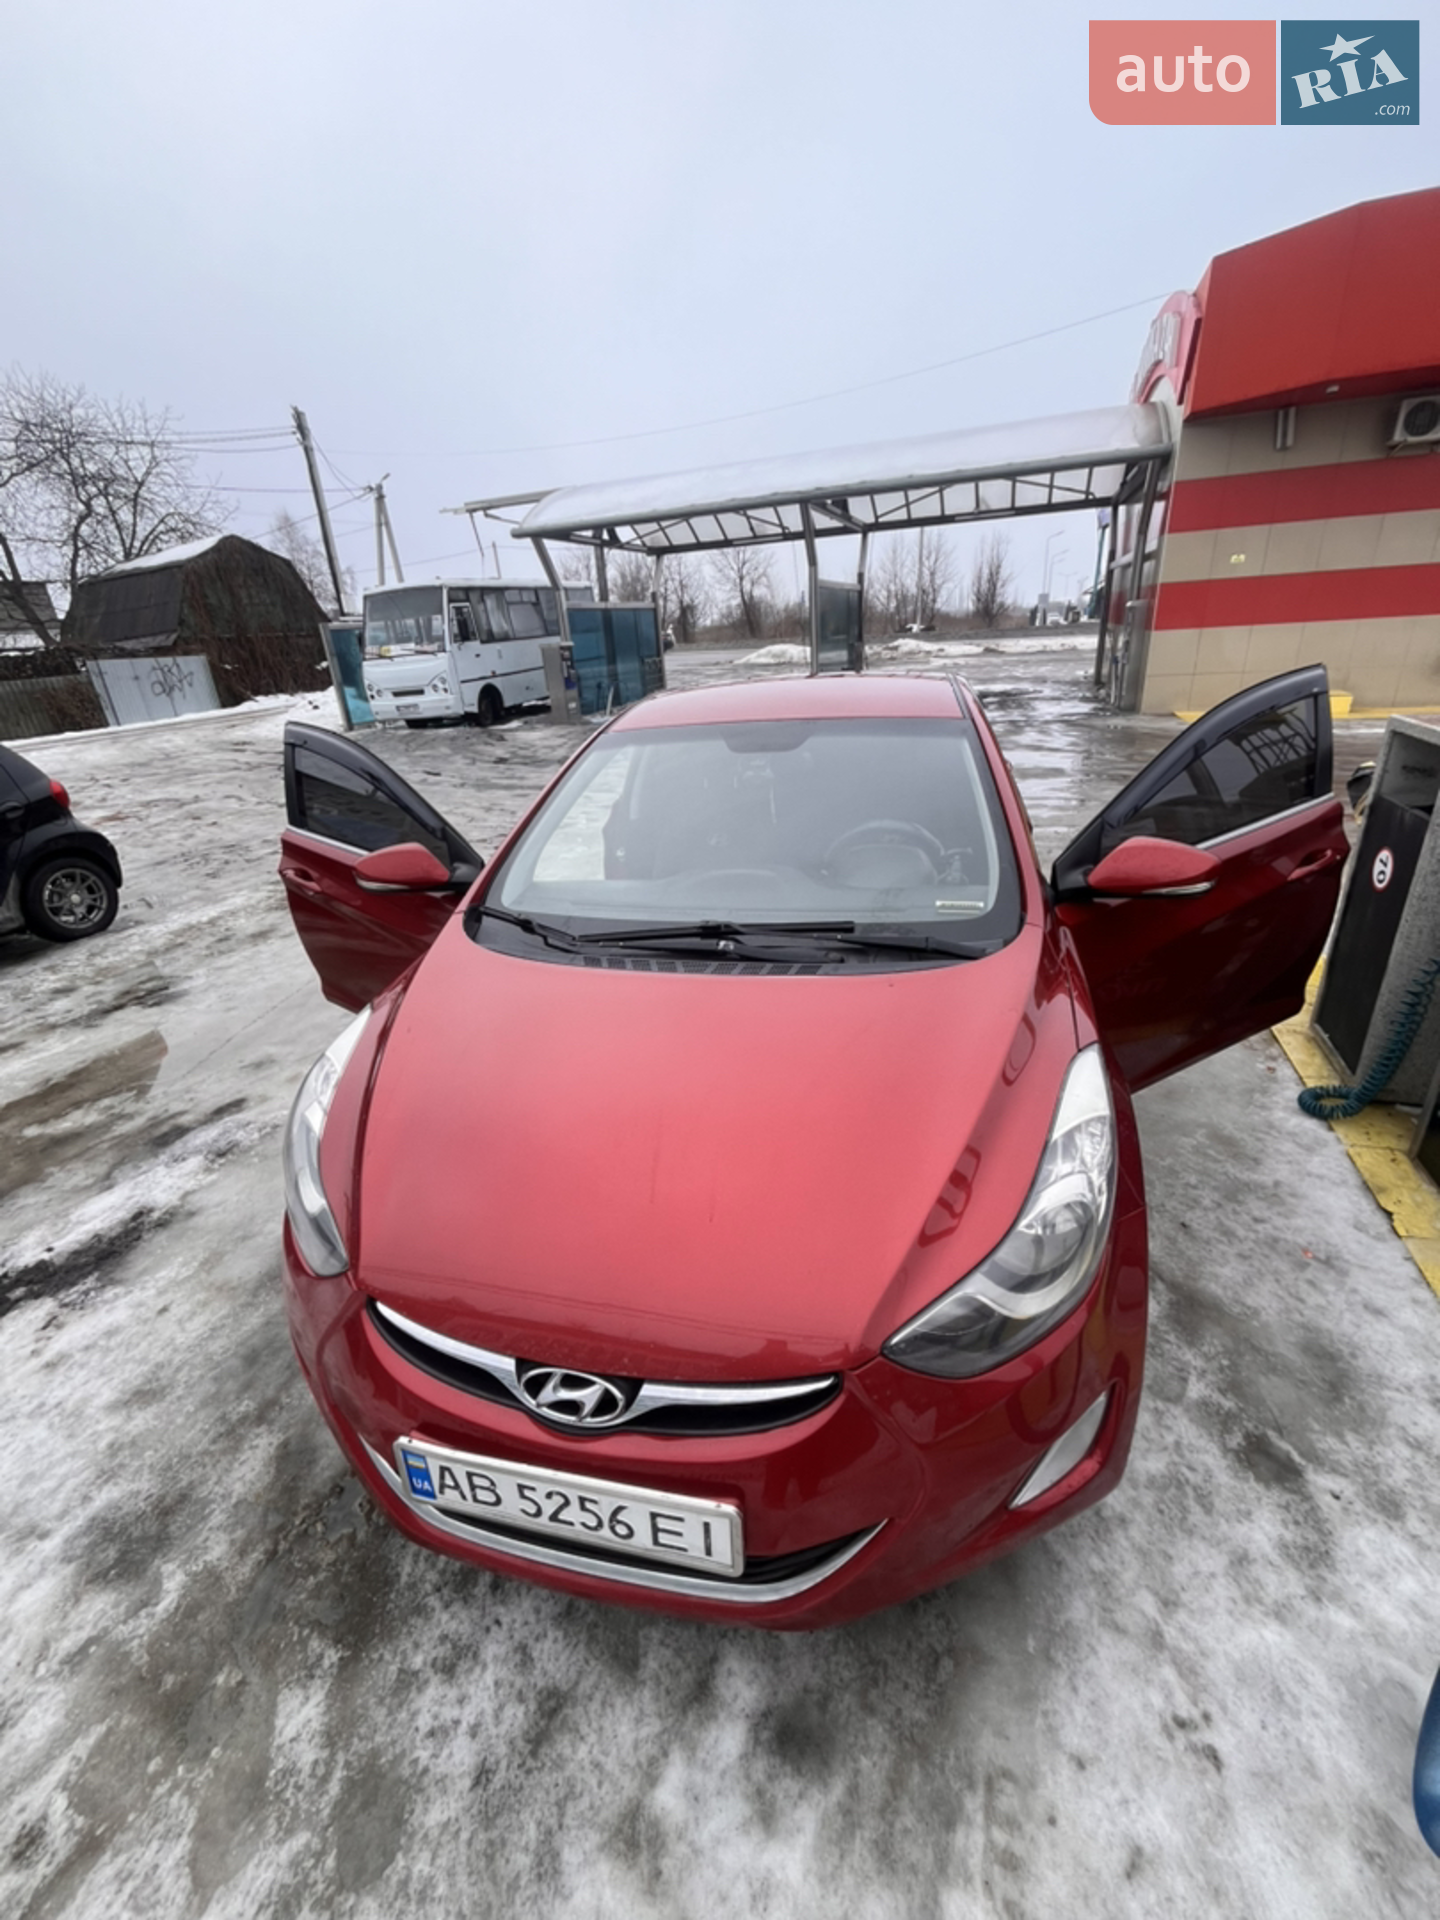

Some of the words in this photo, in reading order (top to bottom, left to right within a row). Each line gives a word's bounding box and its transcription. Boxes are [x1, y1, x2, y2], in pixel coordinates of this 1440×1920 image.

[1376, 855, 1389, 884] 70
[412, 1477, 432, 1492] UA
[438, 1465, 502, 1507] AB
[517, 1483, 635, 1541] 5256
[649, 1511, 712, 1557] EI
